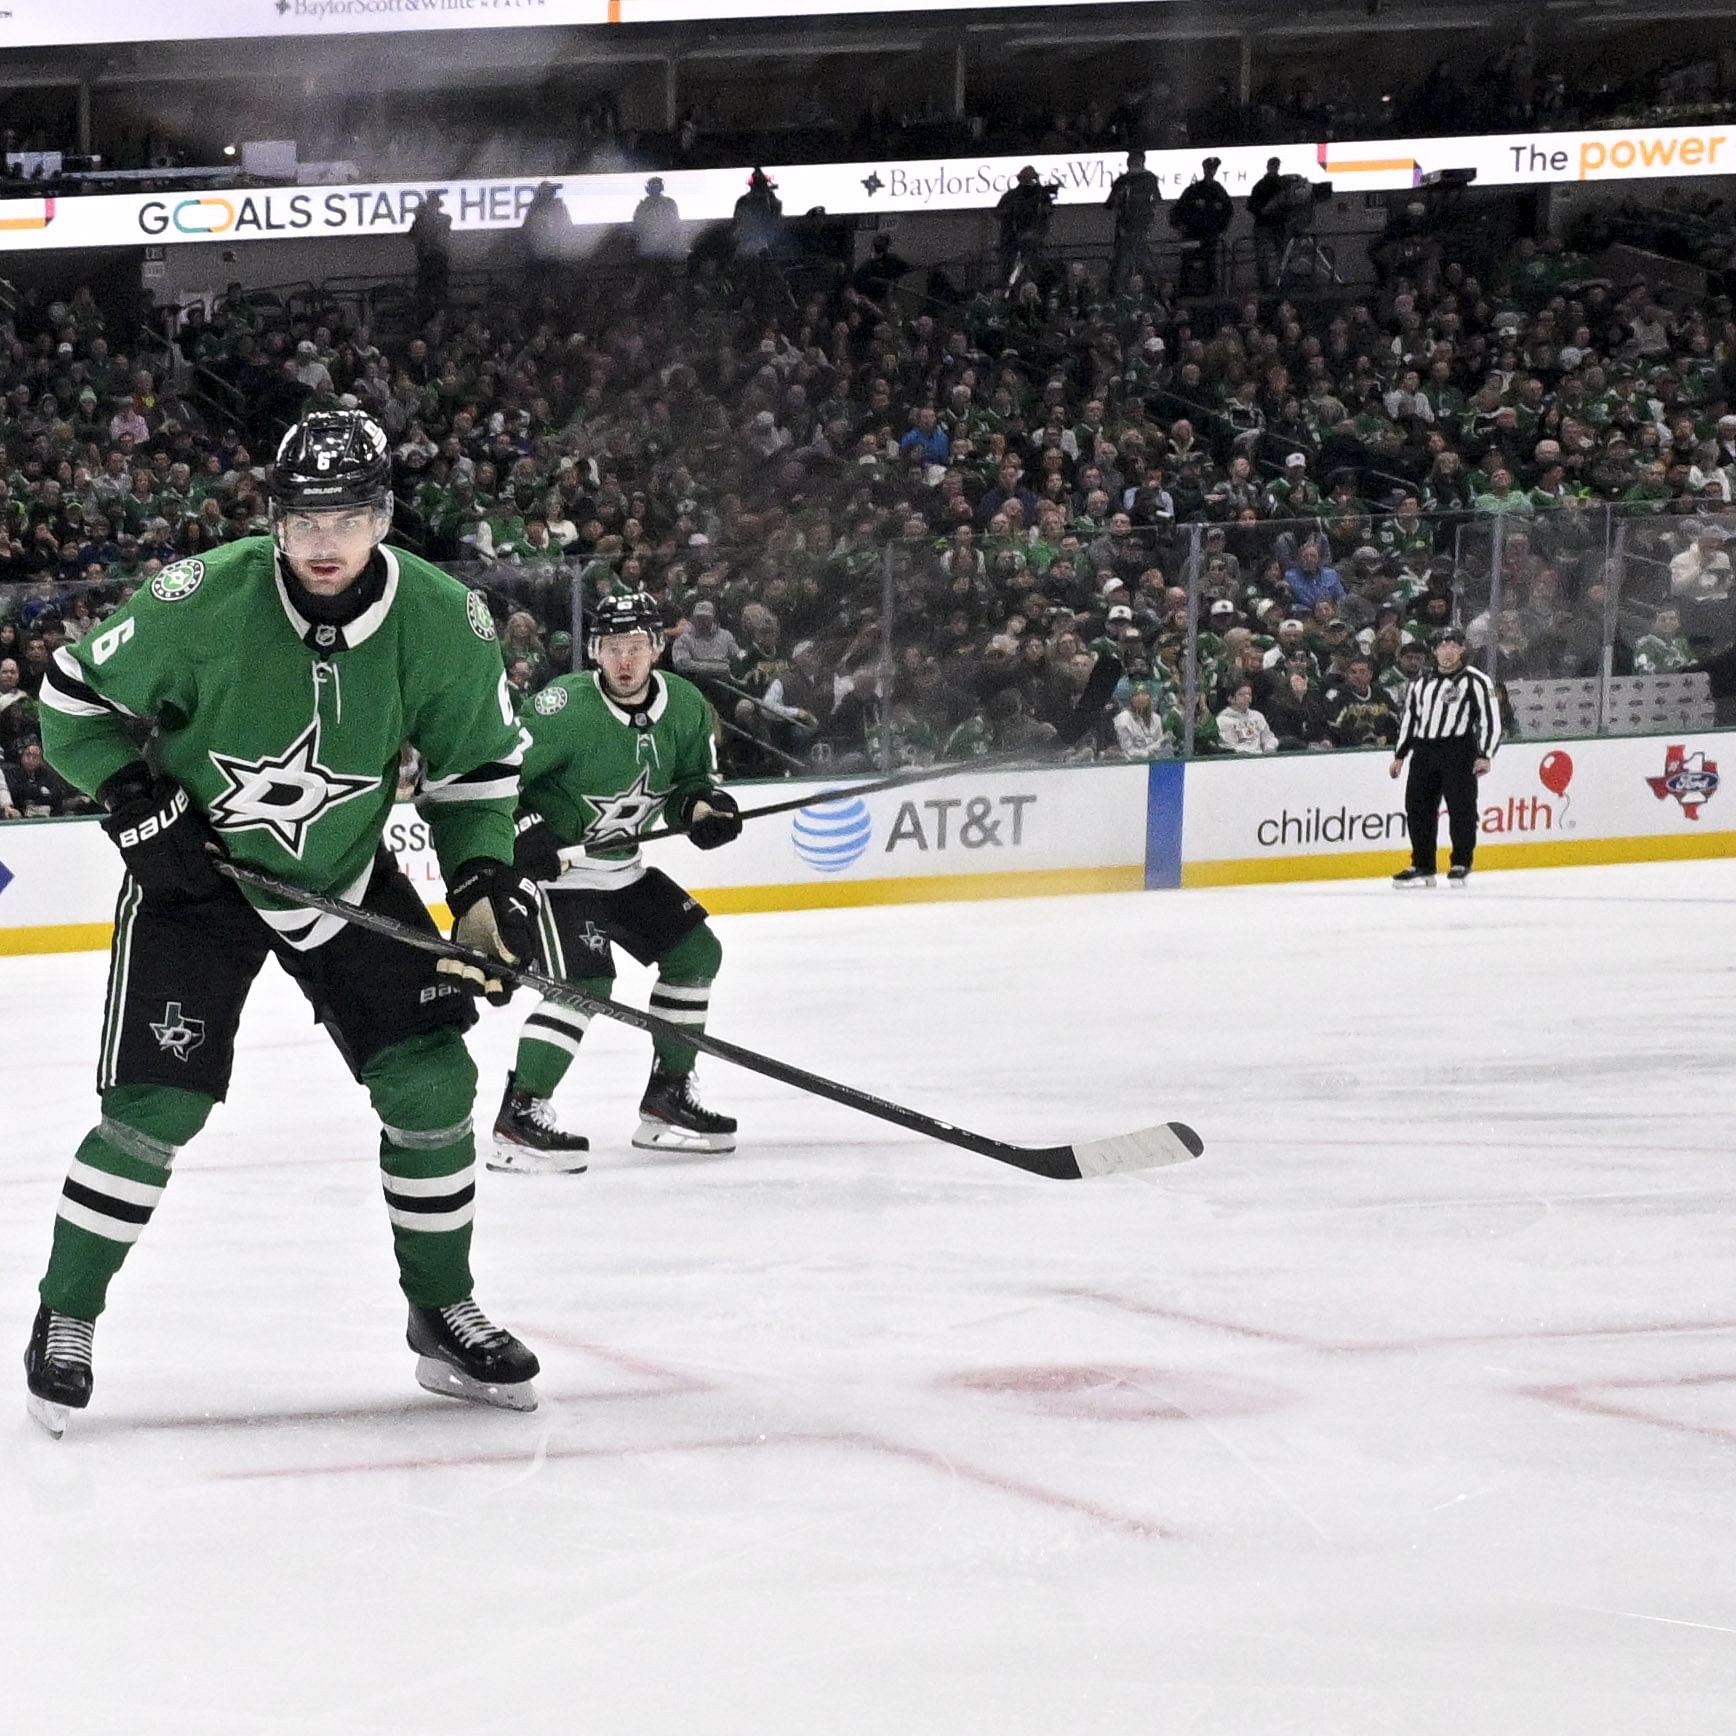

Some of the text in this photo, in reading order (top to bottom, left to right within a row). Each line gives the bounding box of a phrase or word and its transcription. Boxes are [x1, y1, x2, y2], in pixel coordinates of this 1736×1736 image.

[1509, 136, 1727, 181] The power
[884, 794, 1038, 853] AT&T
